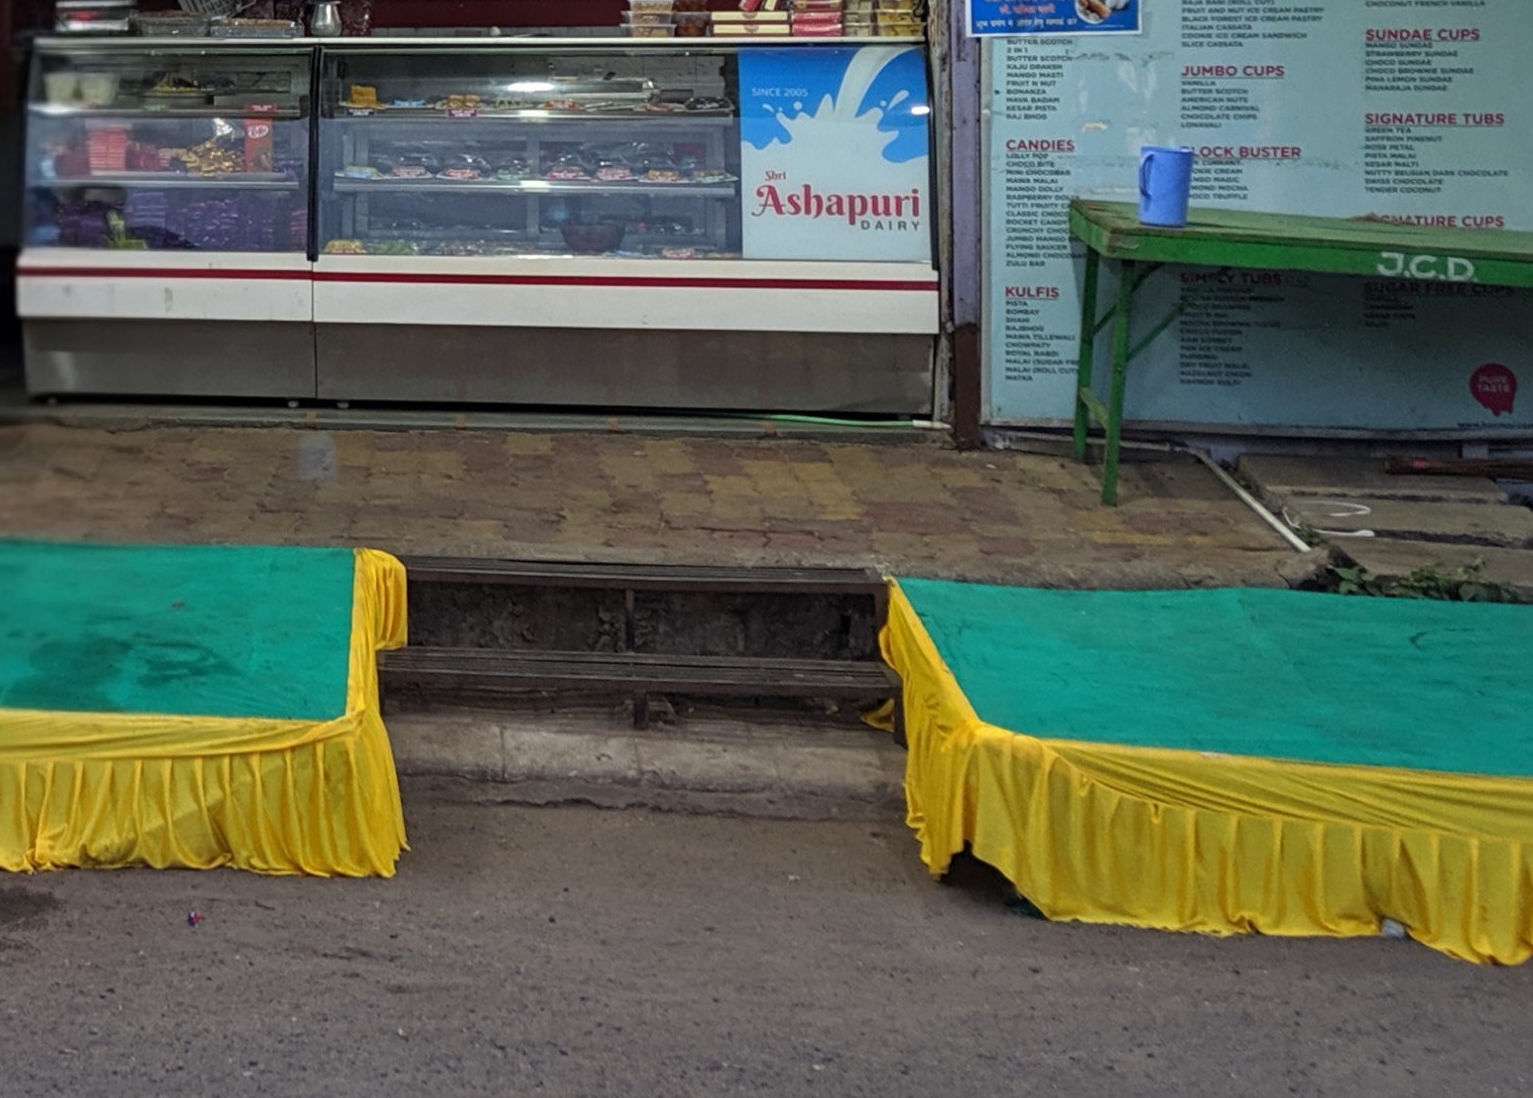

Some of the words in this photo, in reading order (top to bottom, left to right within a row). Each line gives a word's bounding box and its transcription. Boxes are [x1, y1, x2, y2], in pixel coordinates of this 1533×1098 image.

[1365, 29, 1432, 40] SUNDAE
[1437, 29, 1480, 40] CUPS
[1182, 66, 1237, 76] JUMBO
[1243, 66, 1285, 76] CUPS
[752, 88, 780, 97] SINCE
[1365, 113, 1457, 124] SIGNATURE
[1464, 113, 1504, 124] TUBS
[1006, 140, 1075, 151] CANDIES
[1181, 146, 1234, 157] LOCK
[1239, 147, 1301, 157] BUSTER
[765, 171, 786, 180] Shri
[752, 184, 919, 225] Ashapuri
[861, 221, 920, 230] DAIRY
[1462, 216, 1504, 227] CUPS
[1005, 287, 1059, 297] KULFIS
